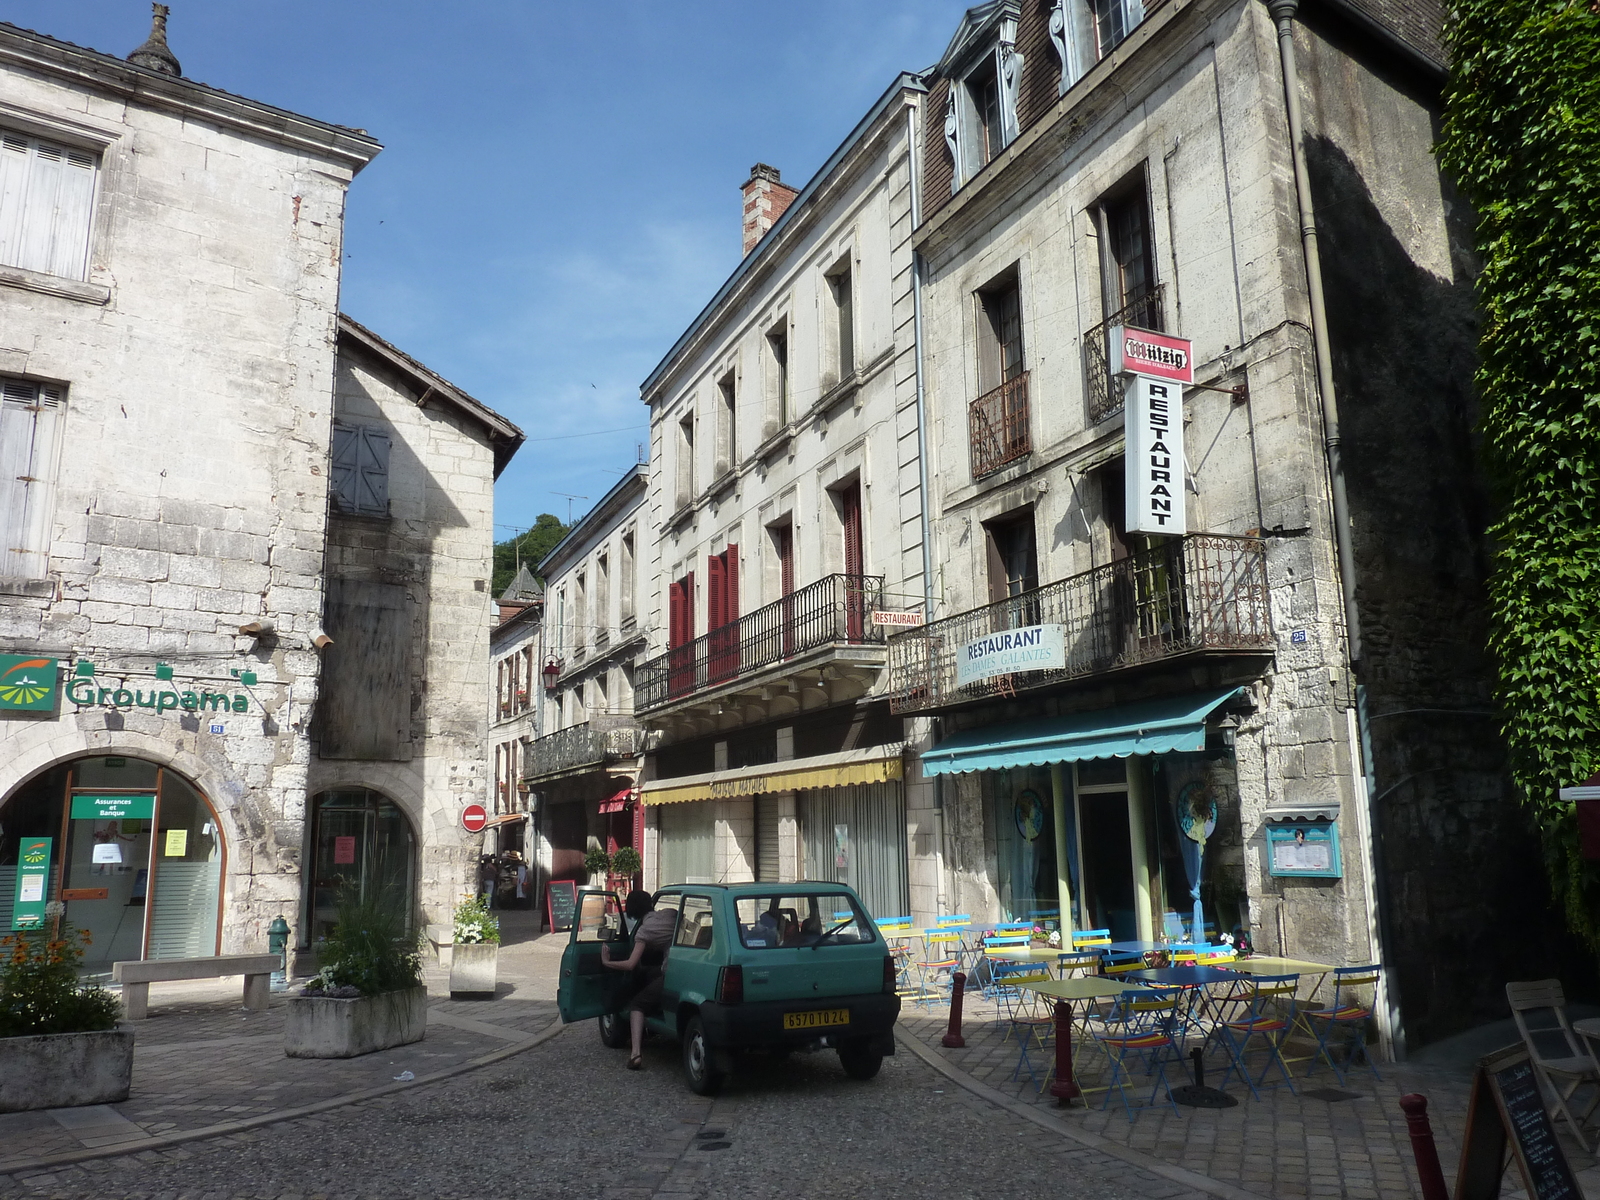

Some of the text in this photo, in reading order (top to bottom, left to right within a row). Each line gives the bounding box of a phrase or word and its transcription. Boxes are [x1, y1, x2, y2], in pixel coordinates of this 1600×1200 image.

[1149, 383, 1171, 526] RESTAURANT
[875, 613, 921, 625] RESTAURANT
[968, 628, 1042, 660] RESTAURANT
[1293, 631, 1305, 642] 25
[961, 647, 1052, 678] LES DAMES GALANTES
[65, 678, 248, 714] Groupama
[212, 725, 222, 733] 51
[789, 1013, 815, 1027] 6570
[832, 1010, 845, 1023] 24
